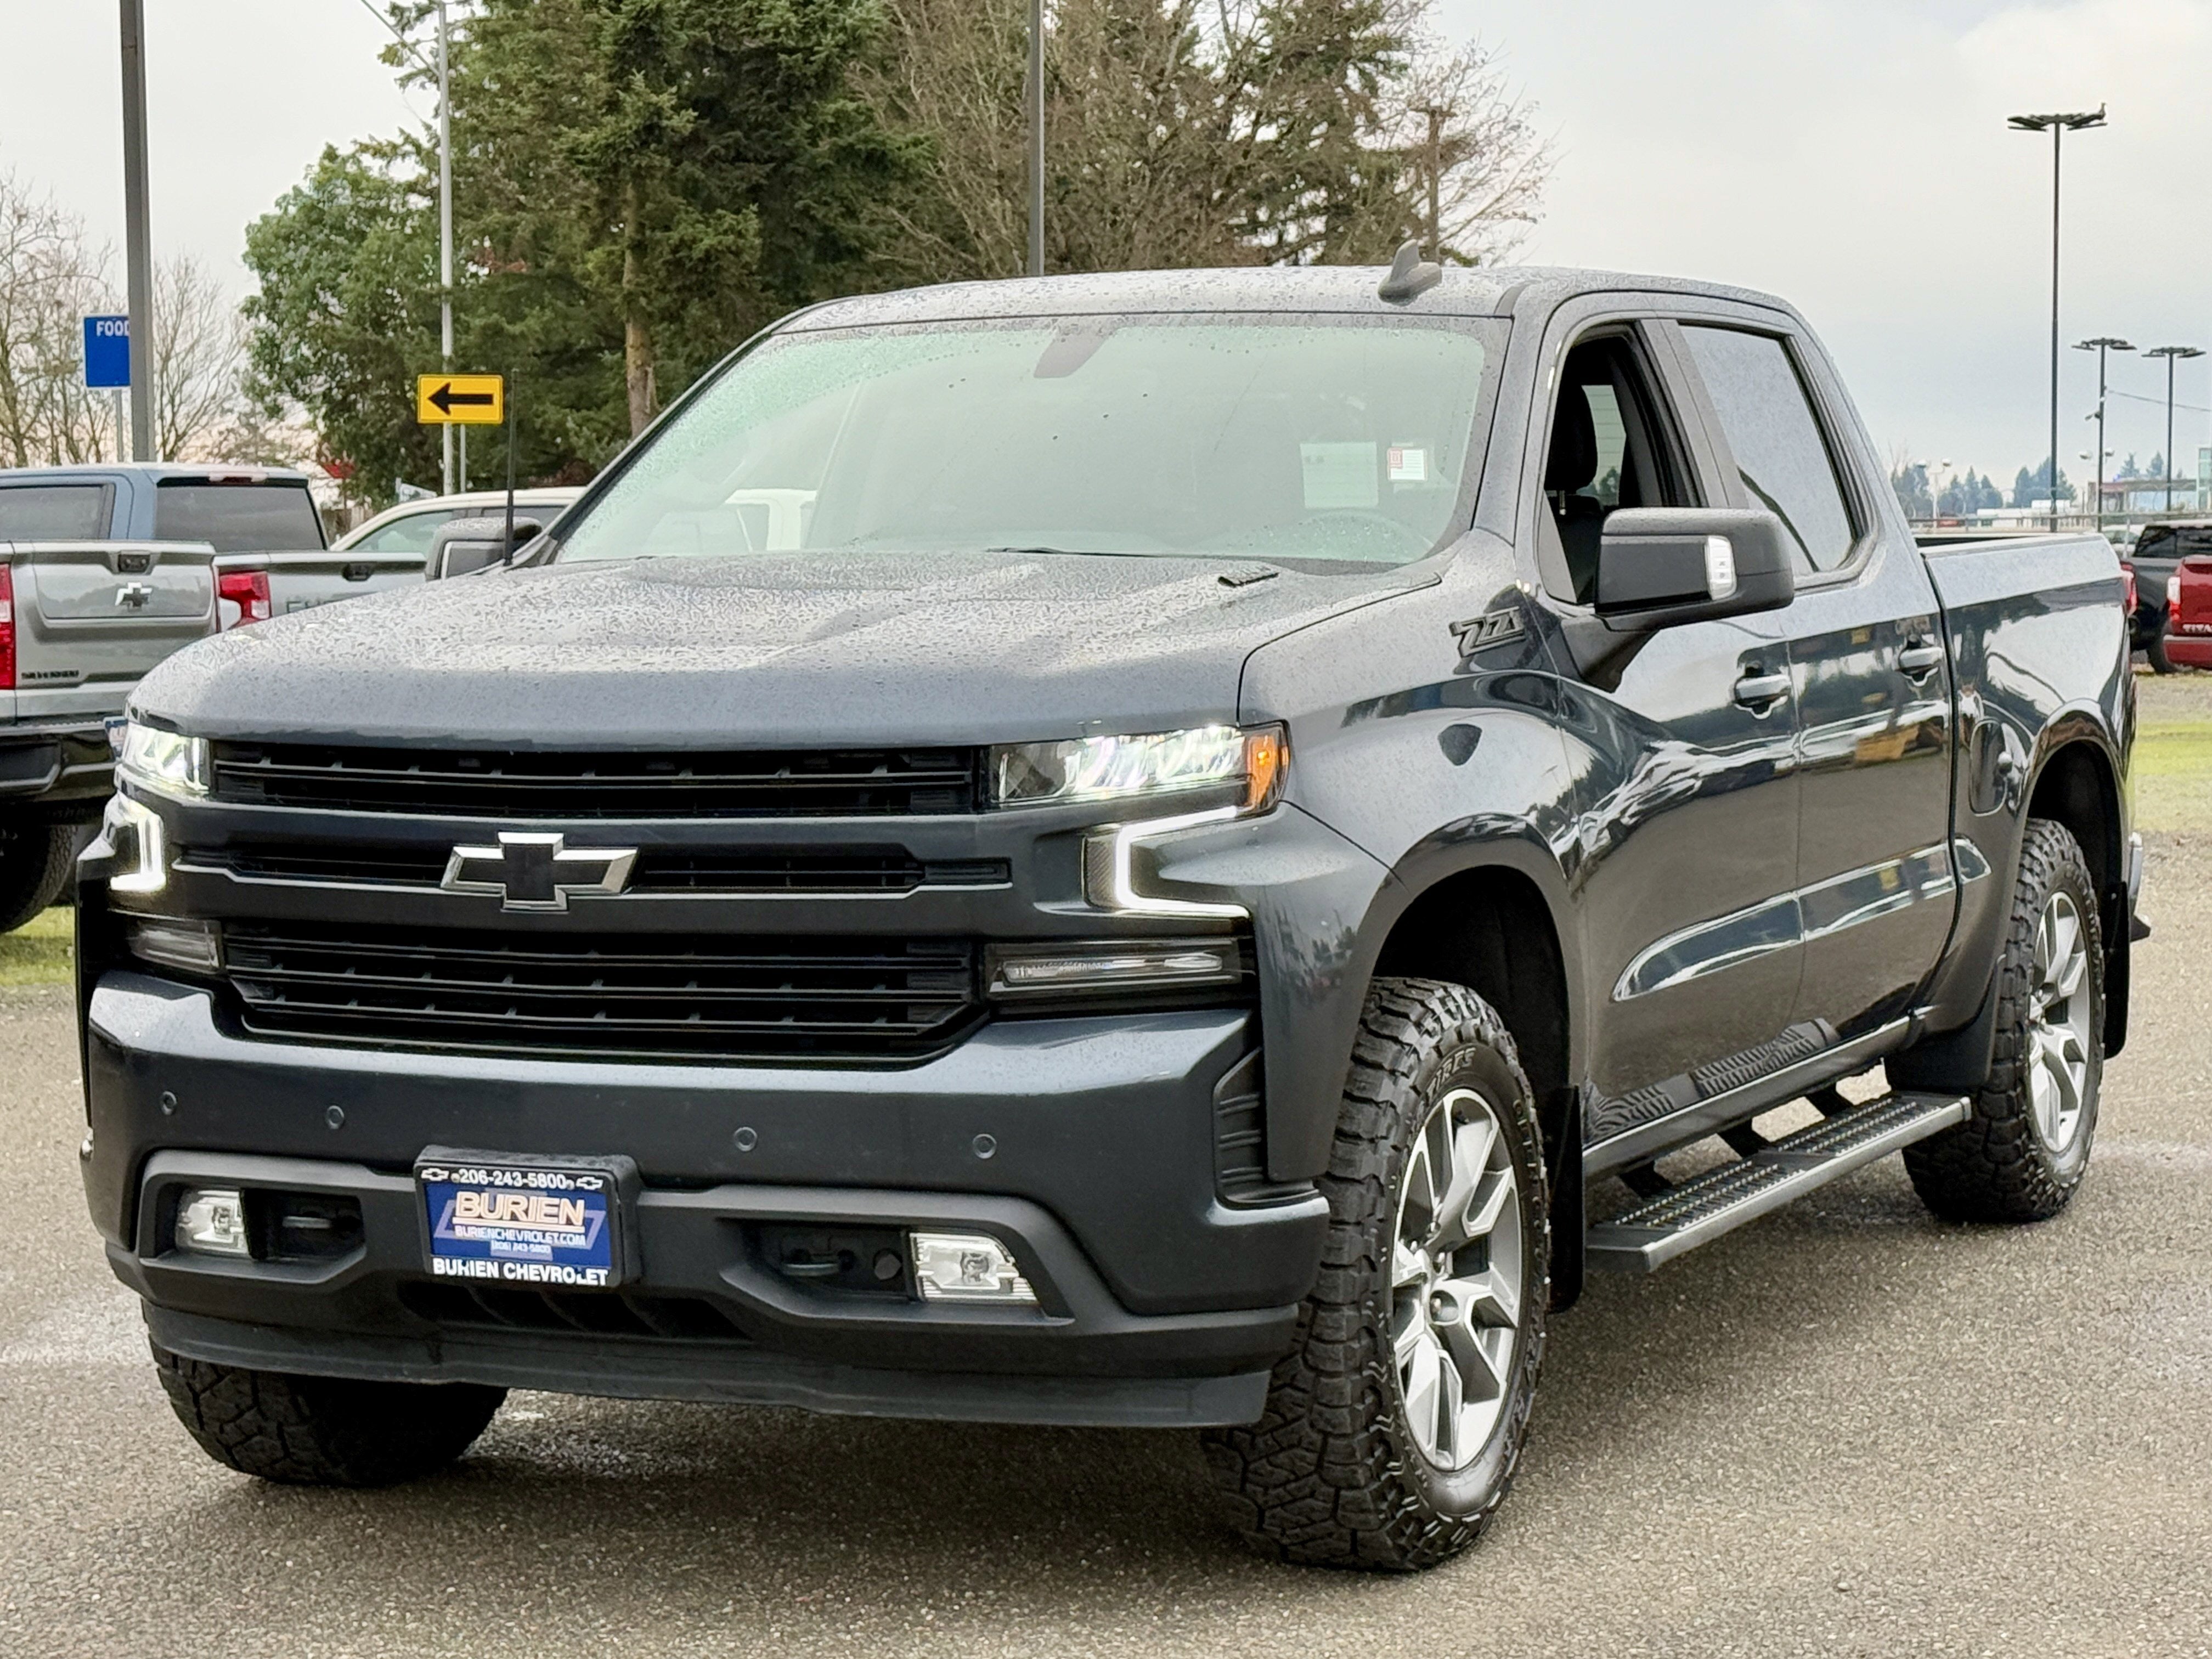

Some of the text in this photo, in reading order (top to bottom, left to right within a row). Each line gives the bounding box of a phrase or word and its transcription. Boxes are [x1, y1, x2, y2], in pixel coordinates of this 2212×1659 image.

[2182, 624, 2212, 633] TITA
[459, 1169, 567, 1189] 206-243-5800
[455, 1191, 585, 1226] BURIEN
[433, 1257, 500, 1278] BURIEN
